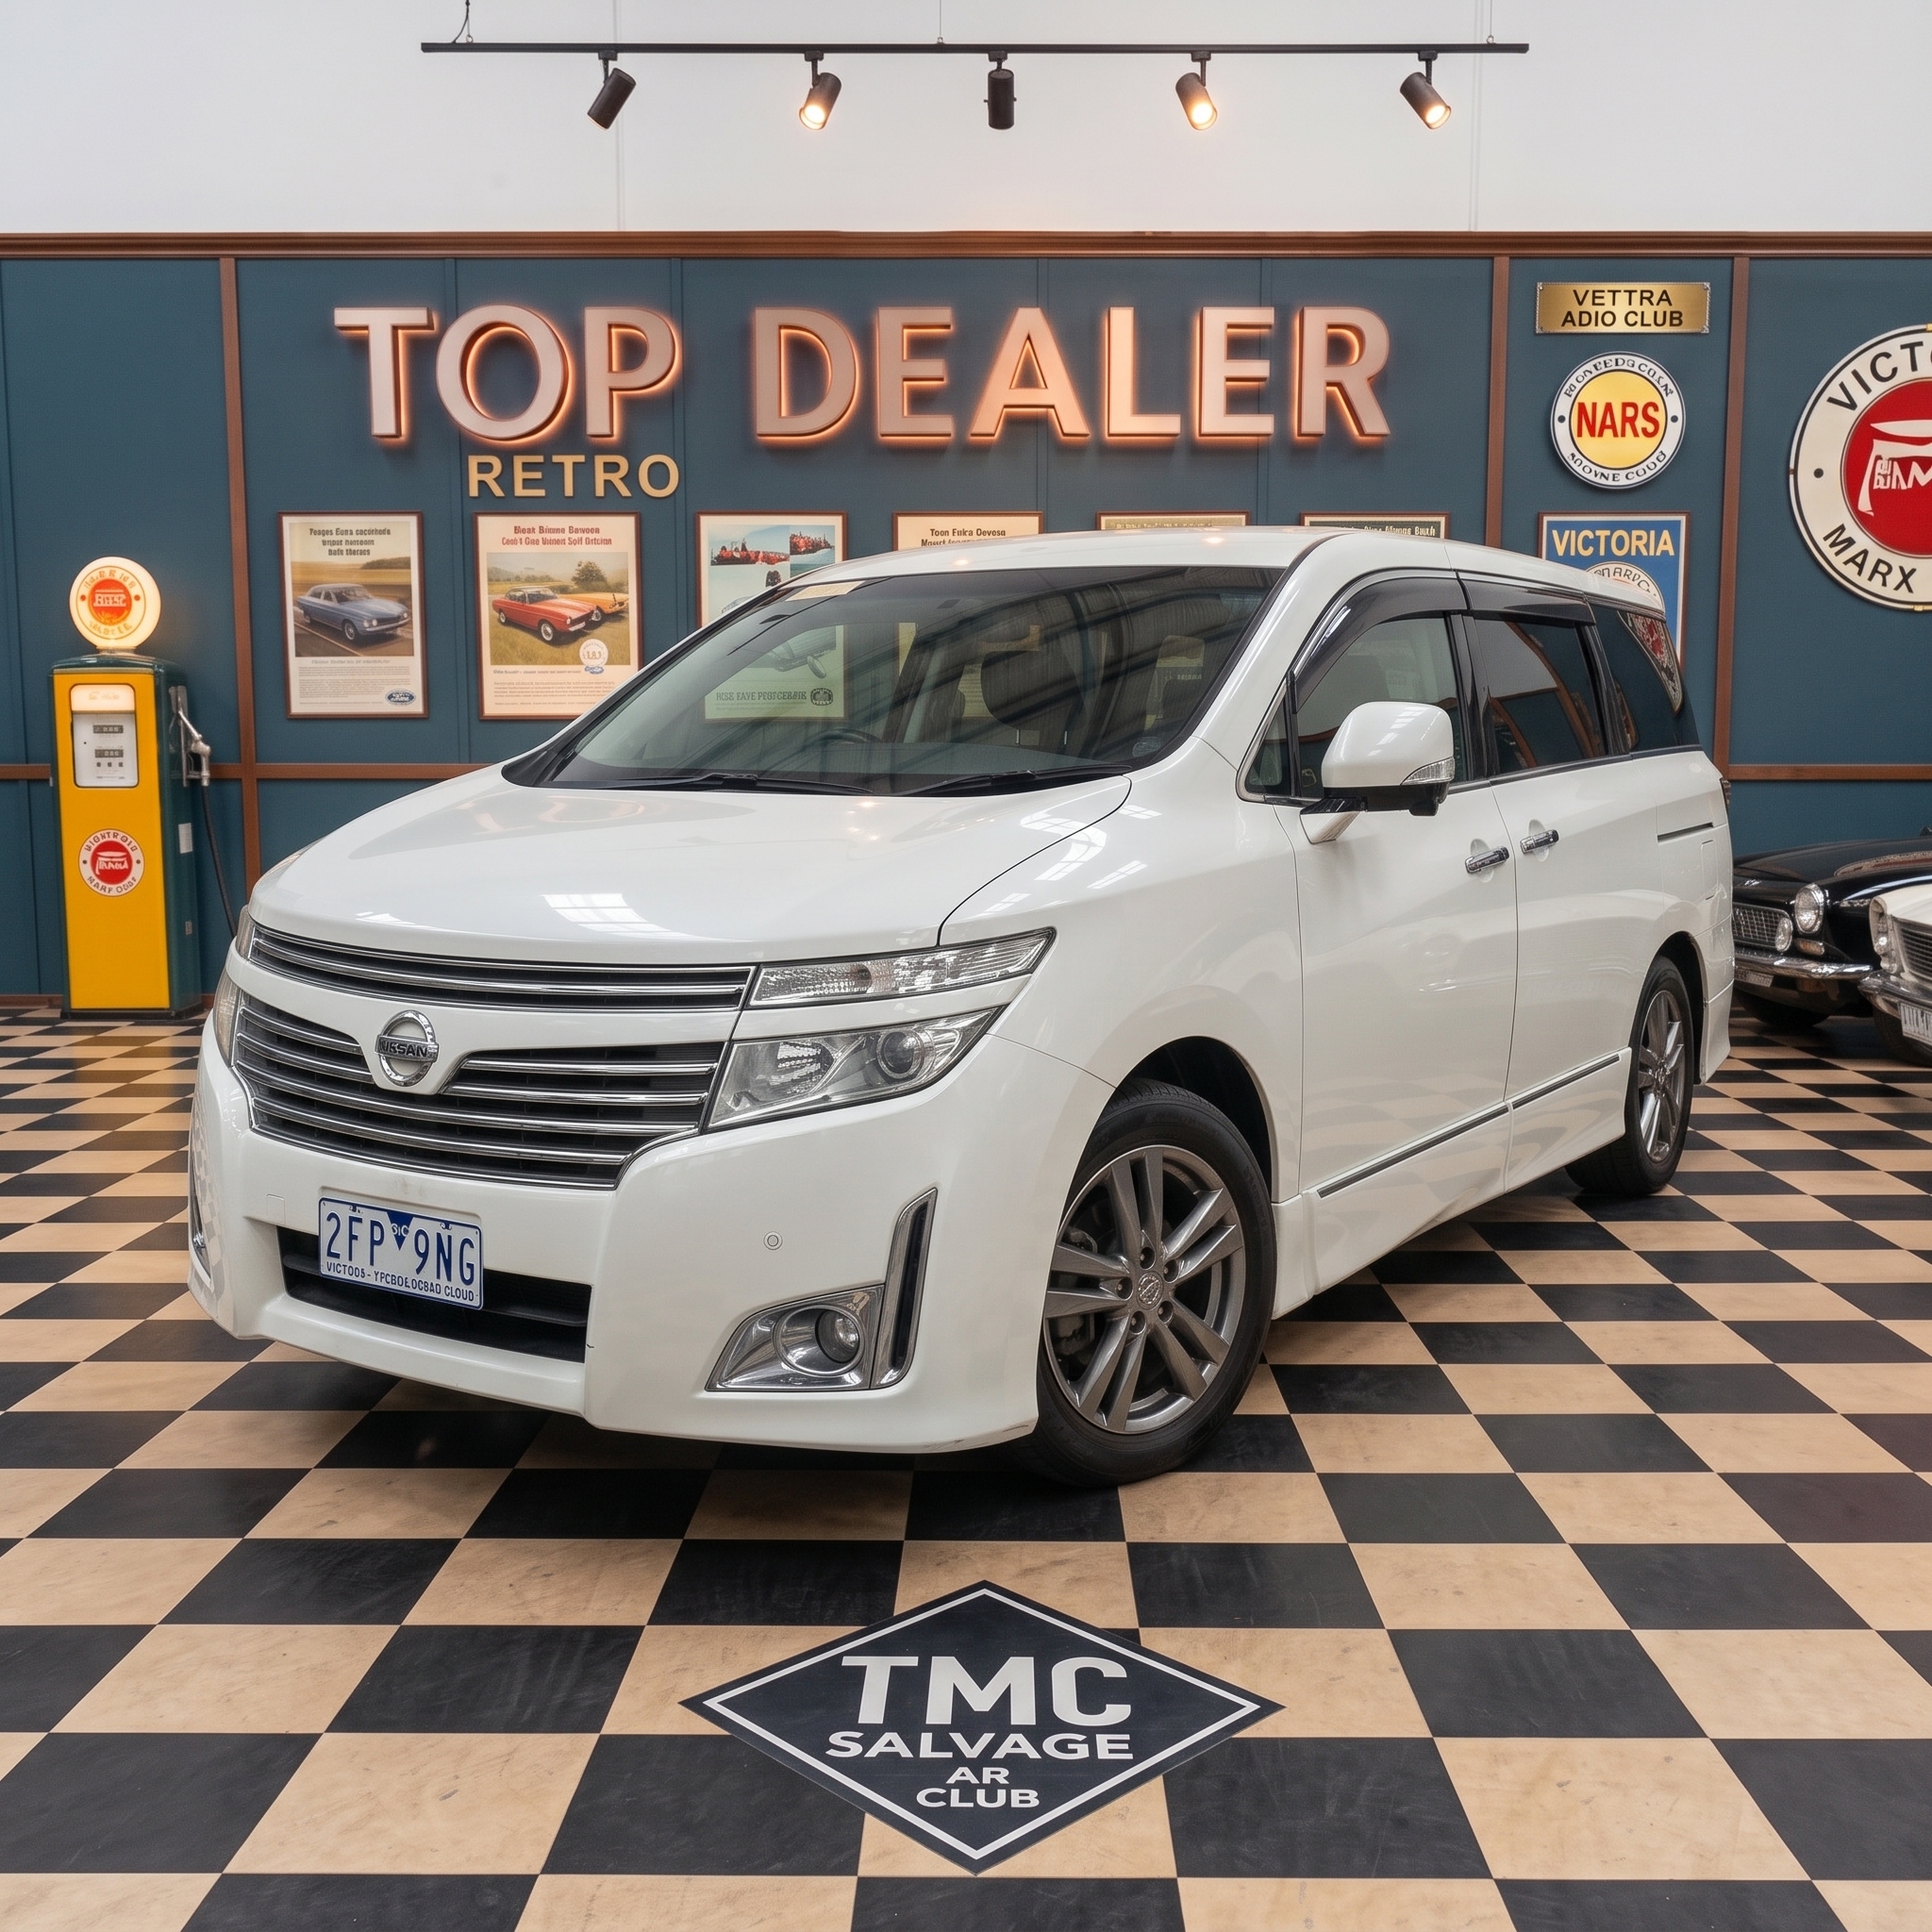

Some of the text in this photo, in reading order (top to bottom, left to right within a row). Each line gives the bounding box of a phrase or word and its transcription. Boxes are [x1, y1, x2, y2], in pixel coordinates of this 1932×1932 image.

[1573, 289, 1673, 307] VETTRA
[1561, 310, 1683, 327] ADIO CLUB
[334, 305, 1391, 441] TOP DEALER
[1826, 341, 1932, 411] VICT
[1576, 401, 1660, 439] NARS
[468, 455, 679, 497] RETRO
[1552, 529, 1674, 557] VICTORIA
[1823, 524, 1917, 593] MARX
[379, 1041, 428, 1058] NISSAN
[326, 1211, 475, 1287] 2FP 9NG
[444, 1286, 475, 1302] CLOUD
[841, 1656, 1132, 1726] TMC
[825, 1731, 1134, 1760] SALVAGE
[945, 1766, 1010, 1785] AR
[916, 1788, 1041, 1808] CLUB
